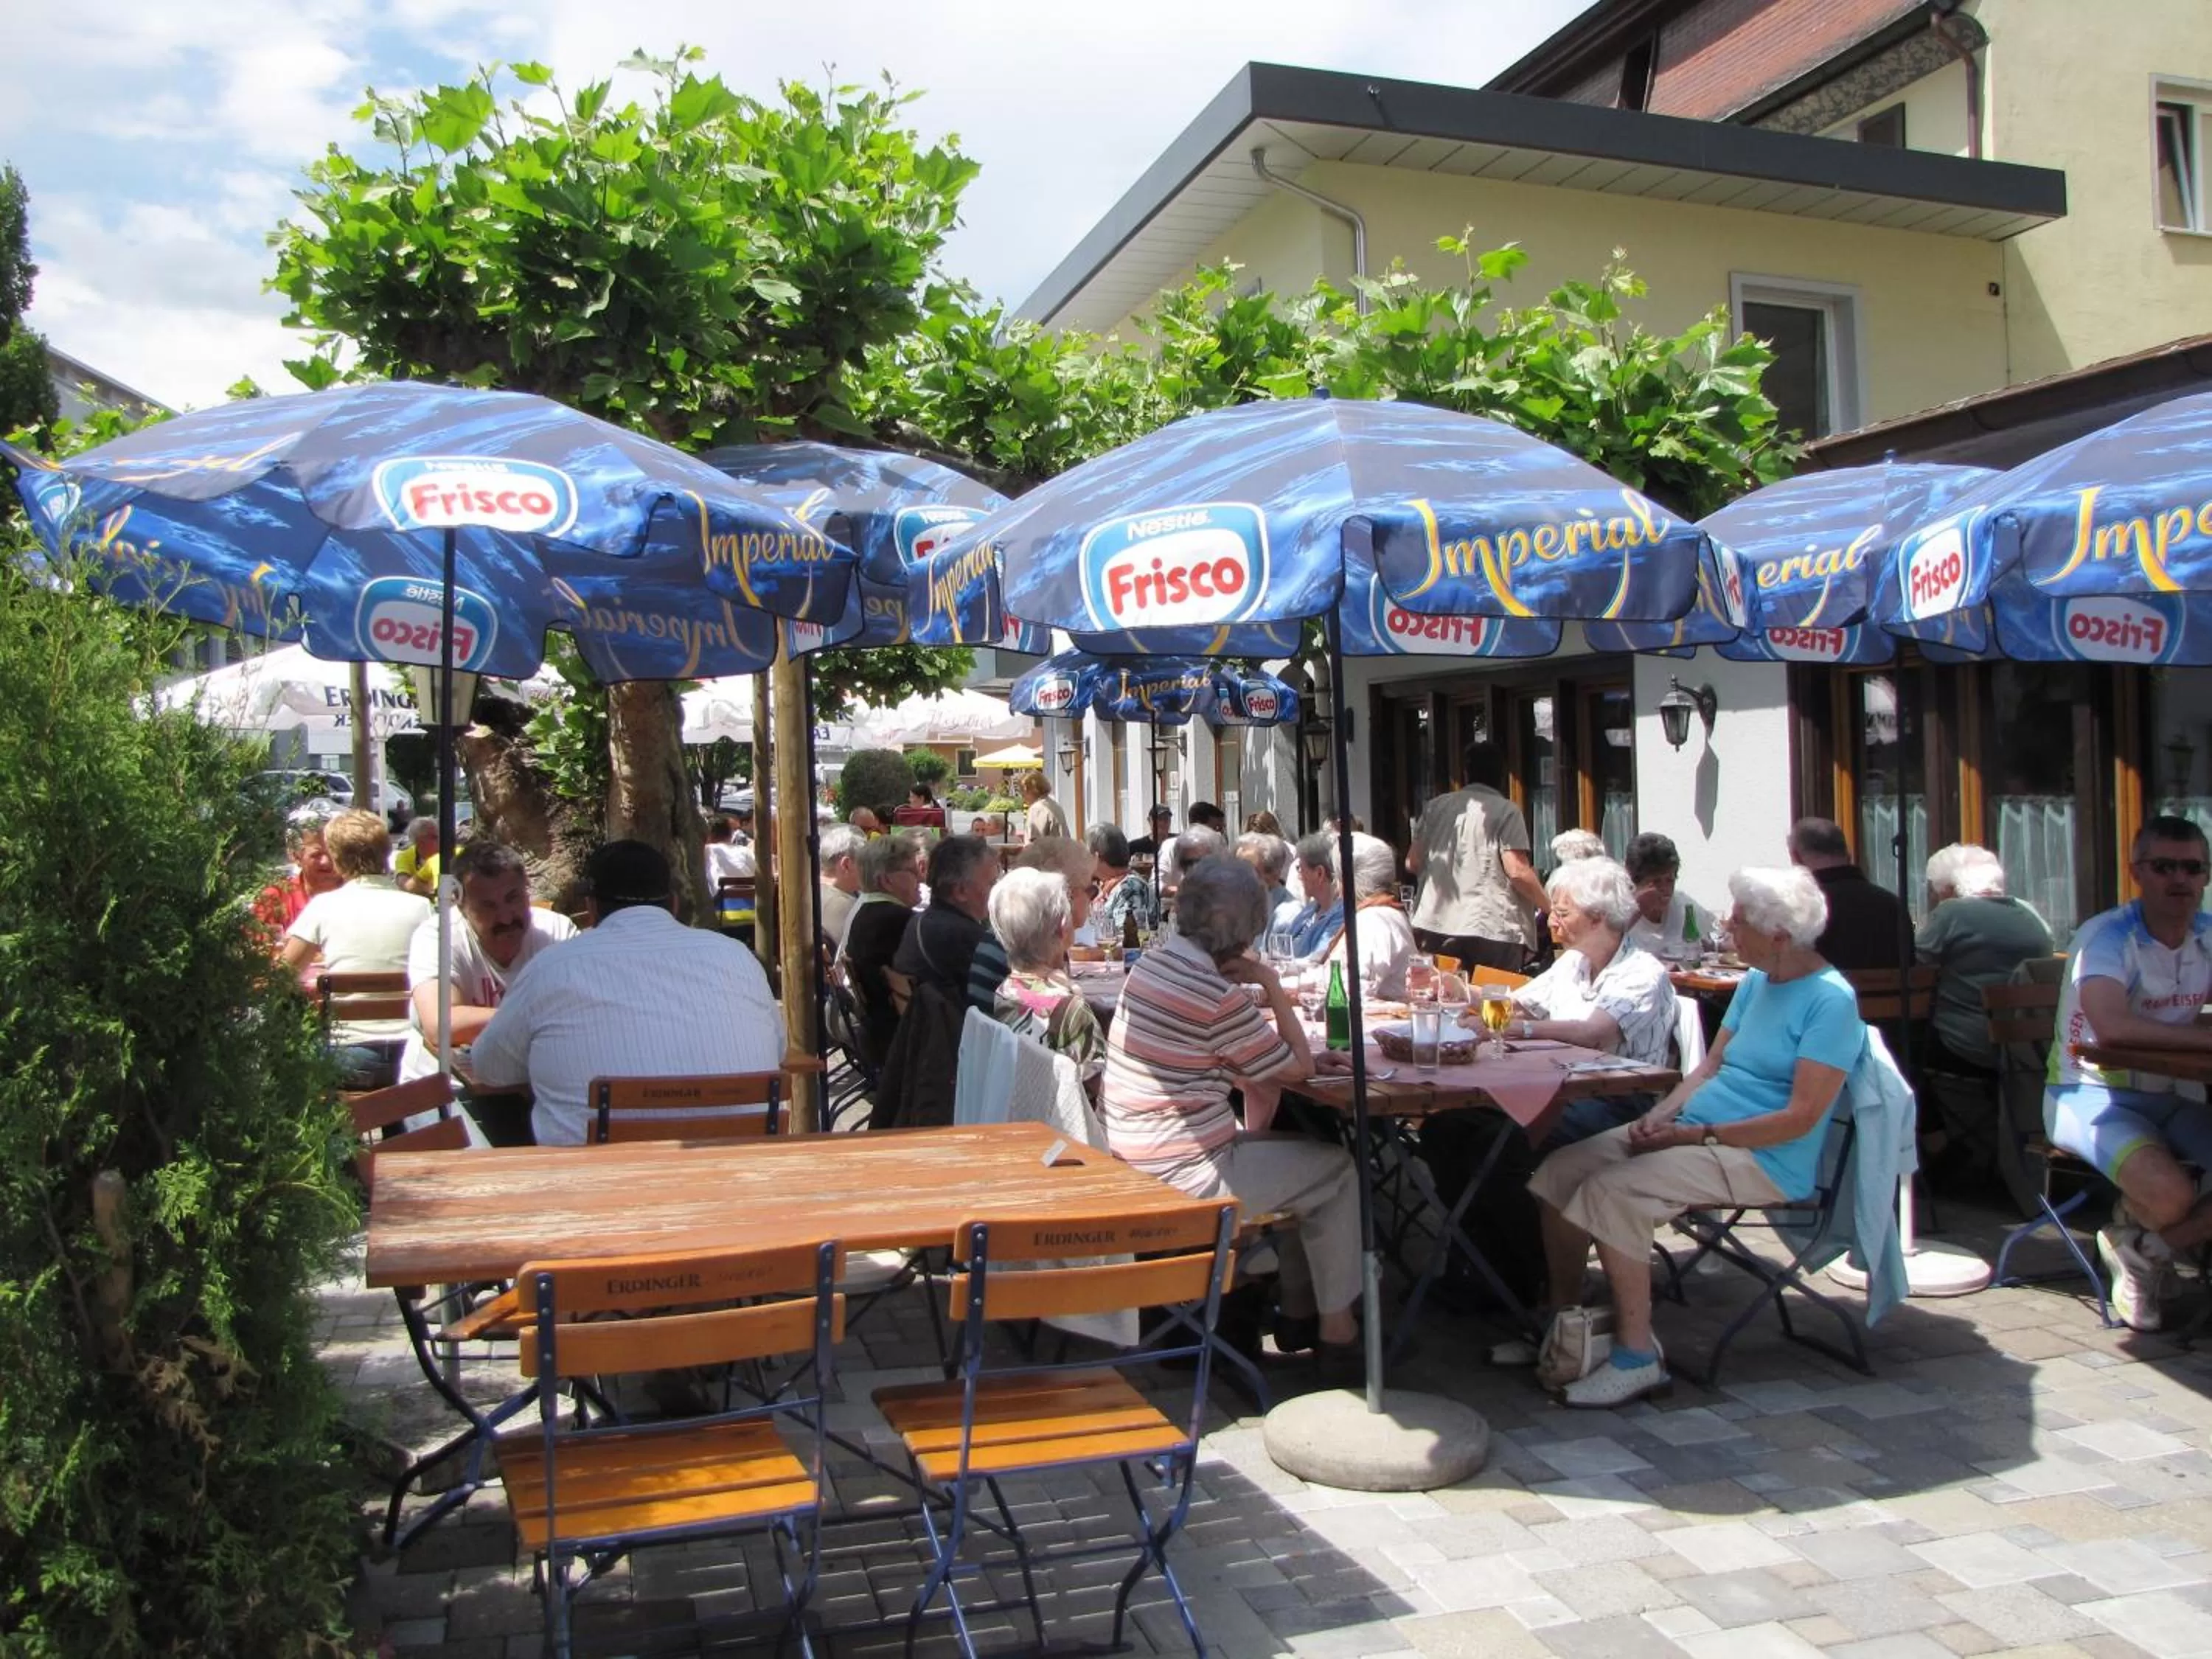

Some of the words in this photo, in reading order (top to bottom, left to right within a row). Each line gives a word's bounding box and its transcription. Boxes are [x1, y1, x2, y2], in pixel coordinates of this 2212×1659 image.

[409, 483, 553, 521] Frisco
[1399, 489, 1670, 618] Imperial
[1107, 557, 1245, 616] Frisco
[1757, 523, 1882, 627] erial
[1910, 552, 1961, 609] Frisco
[1038, 687, 1069, 704] Frisco
[1248, 695, 1276, 712] Frisco
[1034, 1231, 1116, 1246] ERDINGER
[606, 1273, 701, 1295] ERDINGER
